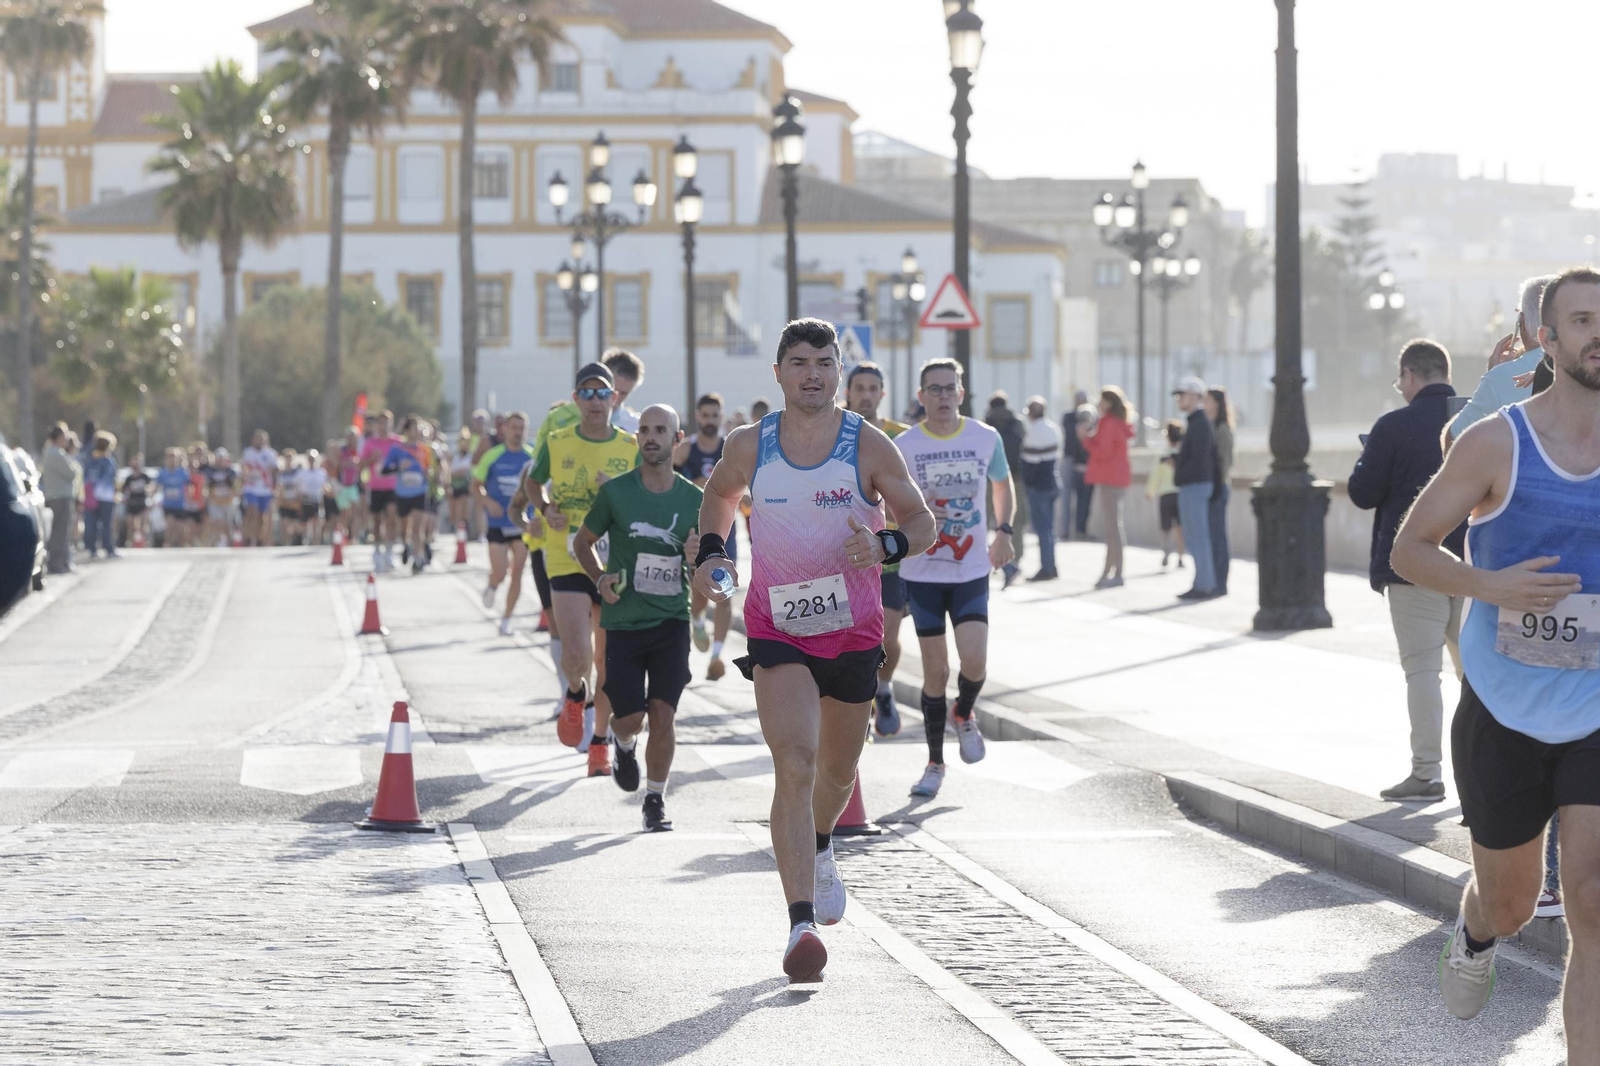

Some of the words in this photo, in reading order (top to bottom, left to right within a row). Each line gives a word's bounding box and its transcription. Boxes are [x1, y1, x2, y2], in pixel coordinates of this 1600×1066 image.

[914, 451, 950, 462] CORRER
[951, 450, 961, 459] ES
[963, 449, 976, 458] UN
[934, 471, 973, 487] 2243
[643, 565, 679, 582] 1768
[783, 592, 839, 621] 2281
[1521, 612, 1578, 643] 995
